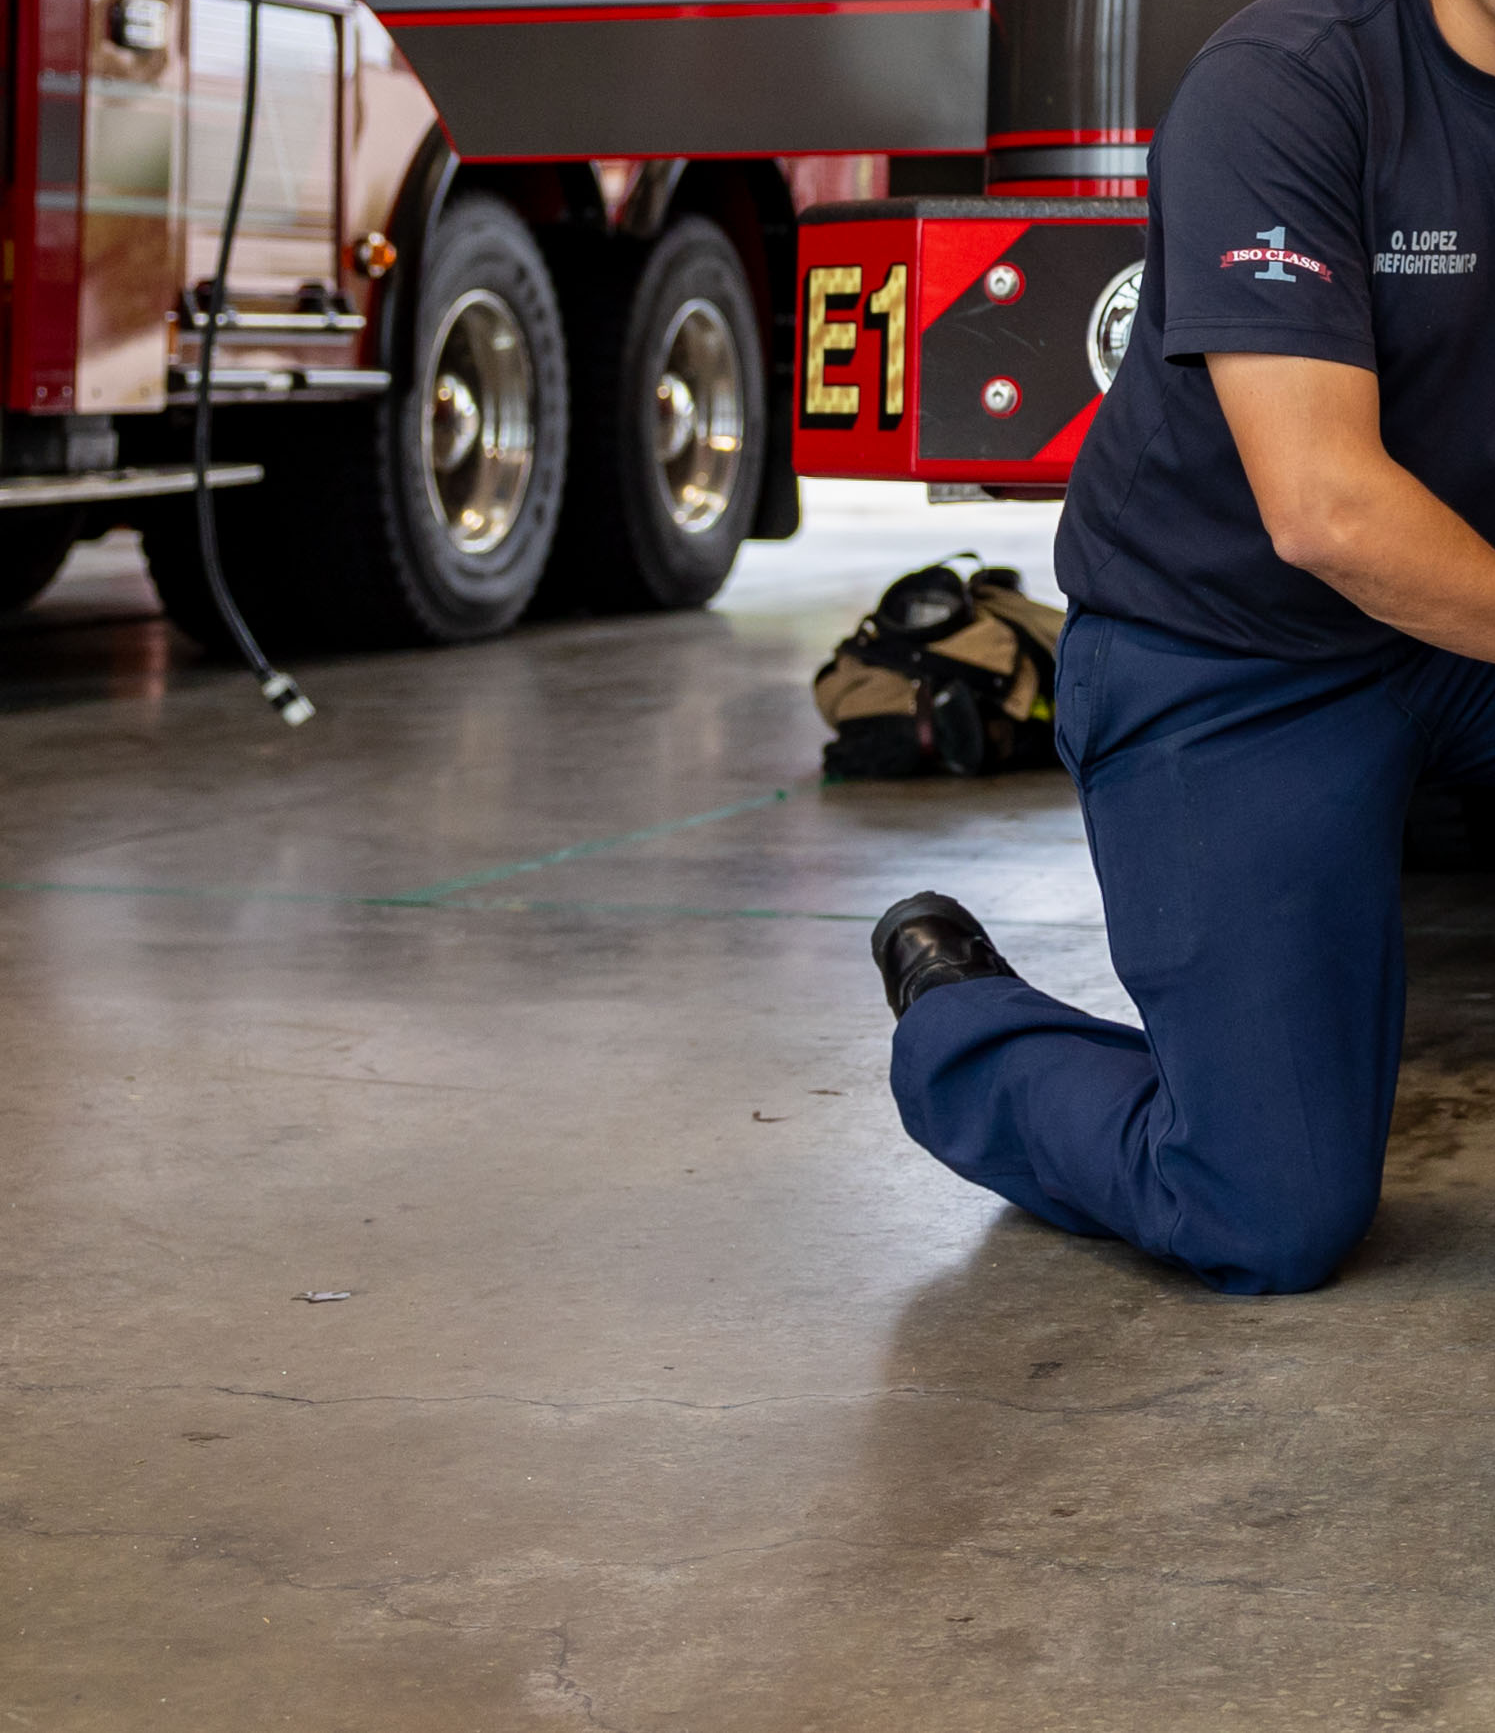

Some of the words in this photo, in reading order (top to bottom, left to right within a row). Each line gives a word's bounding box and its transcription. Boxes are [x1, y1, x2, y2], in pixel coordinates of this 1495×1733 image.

[1391, 230, 1407, 250] O.
[1411, 230, 1458, 251] LOPEZ
[1232, 249, 1262, 261] ISO
[1265, 250, 1321, 272] CLASS
[1373, 253, 1477, 275] IREFIGHTER/EMT-P
[803, 264, 907, 420] E1
